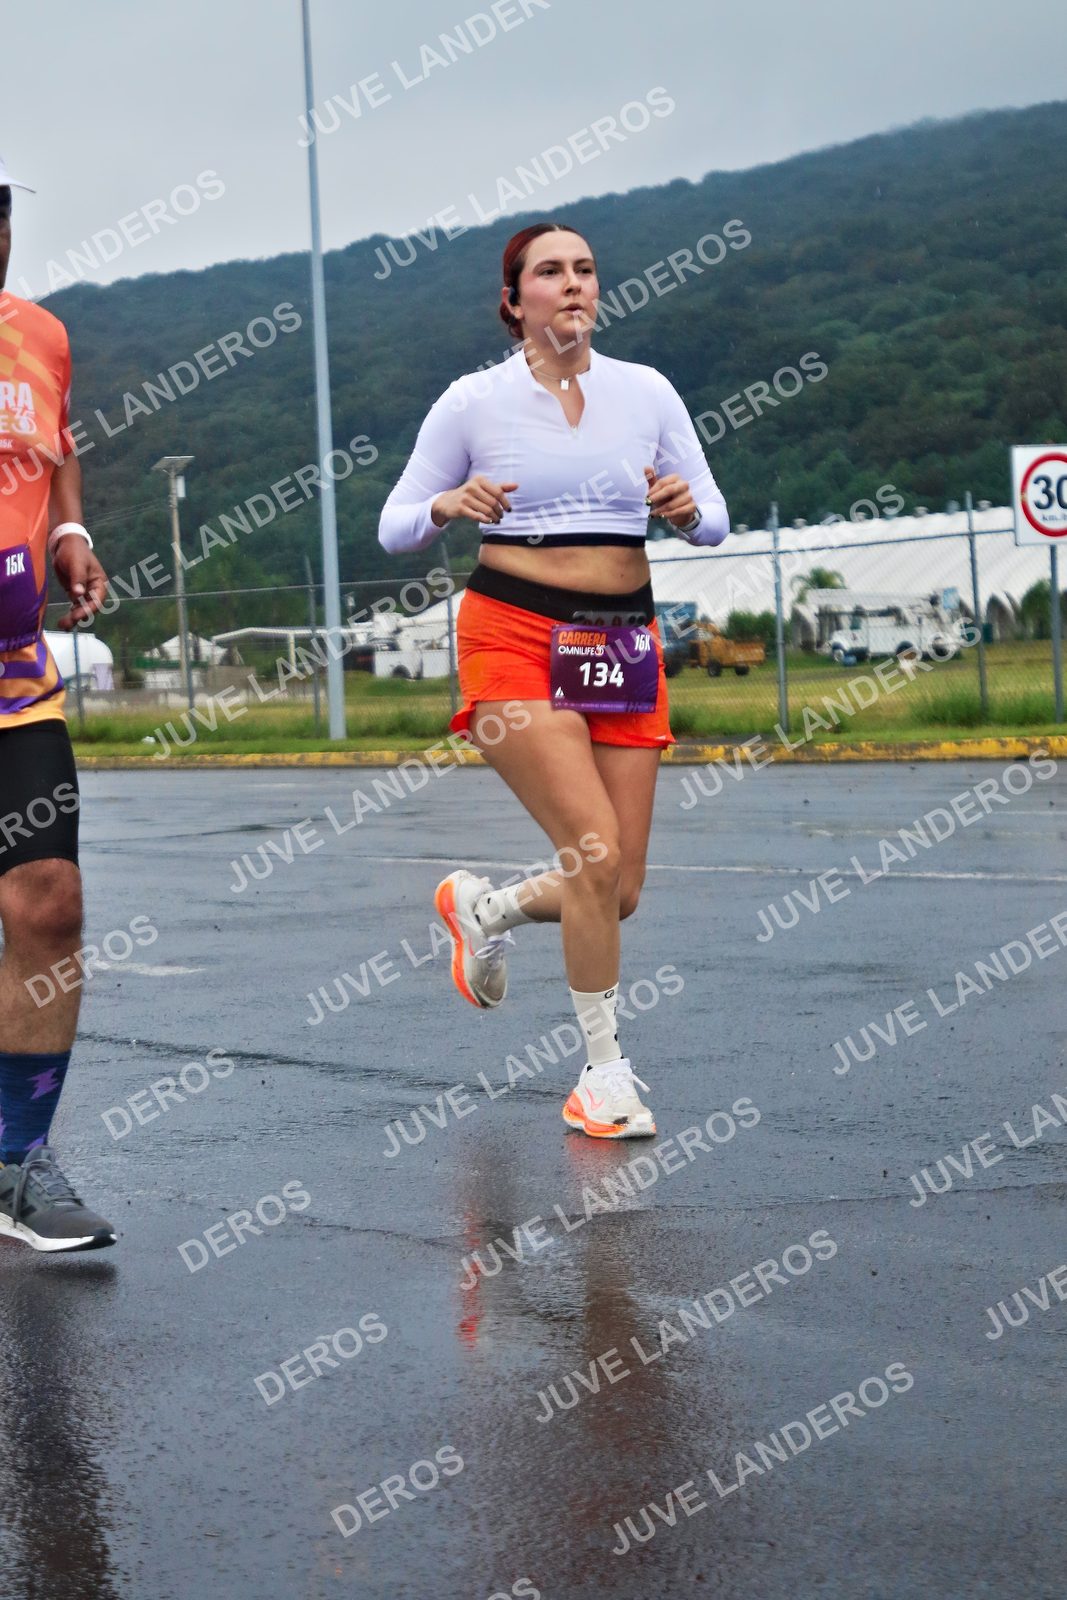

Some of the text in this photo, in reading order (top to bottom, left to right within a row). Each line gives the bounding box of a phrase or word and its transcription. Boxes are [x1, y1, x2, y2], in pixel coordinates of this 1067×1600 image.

[6, 552, 25, 576] 15K
[559, 631, 607, 645] CARRERA
[579, 662, 625, 687] 134
